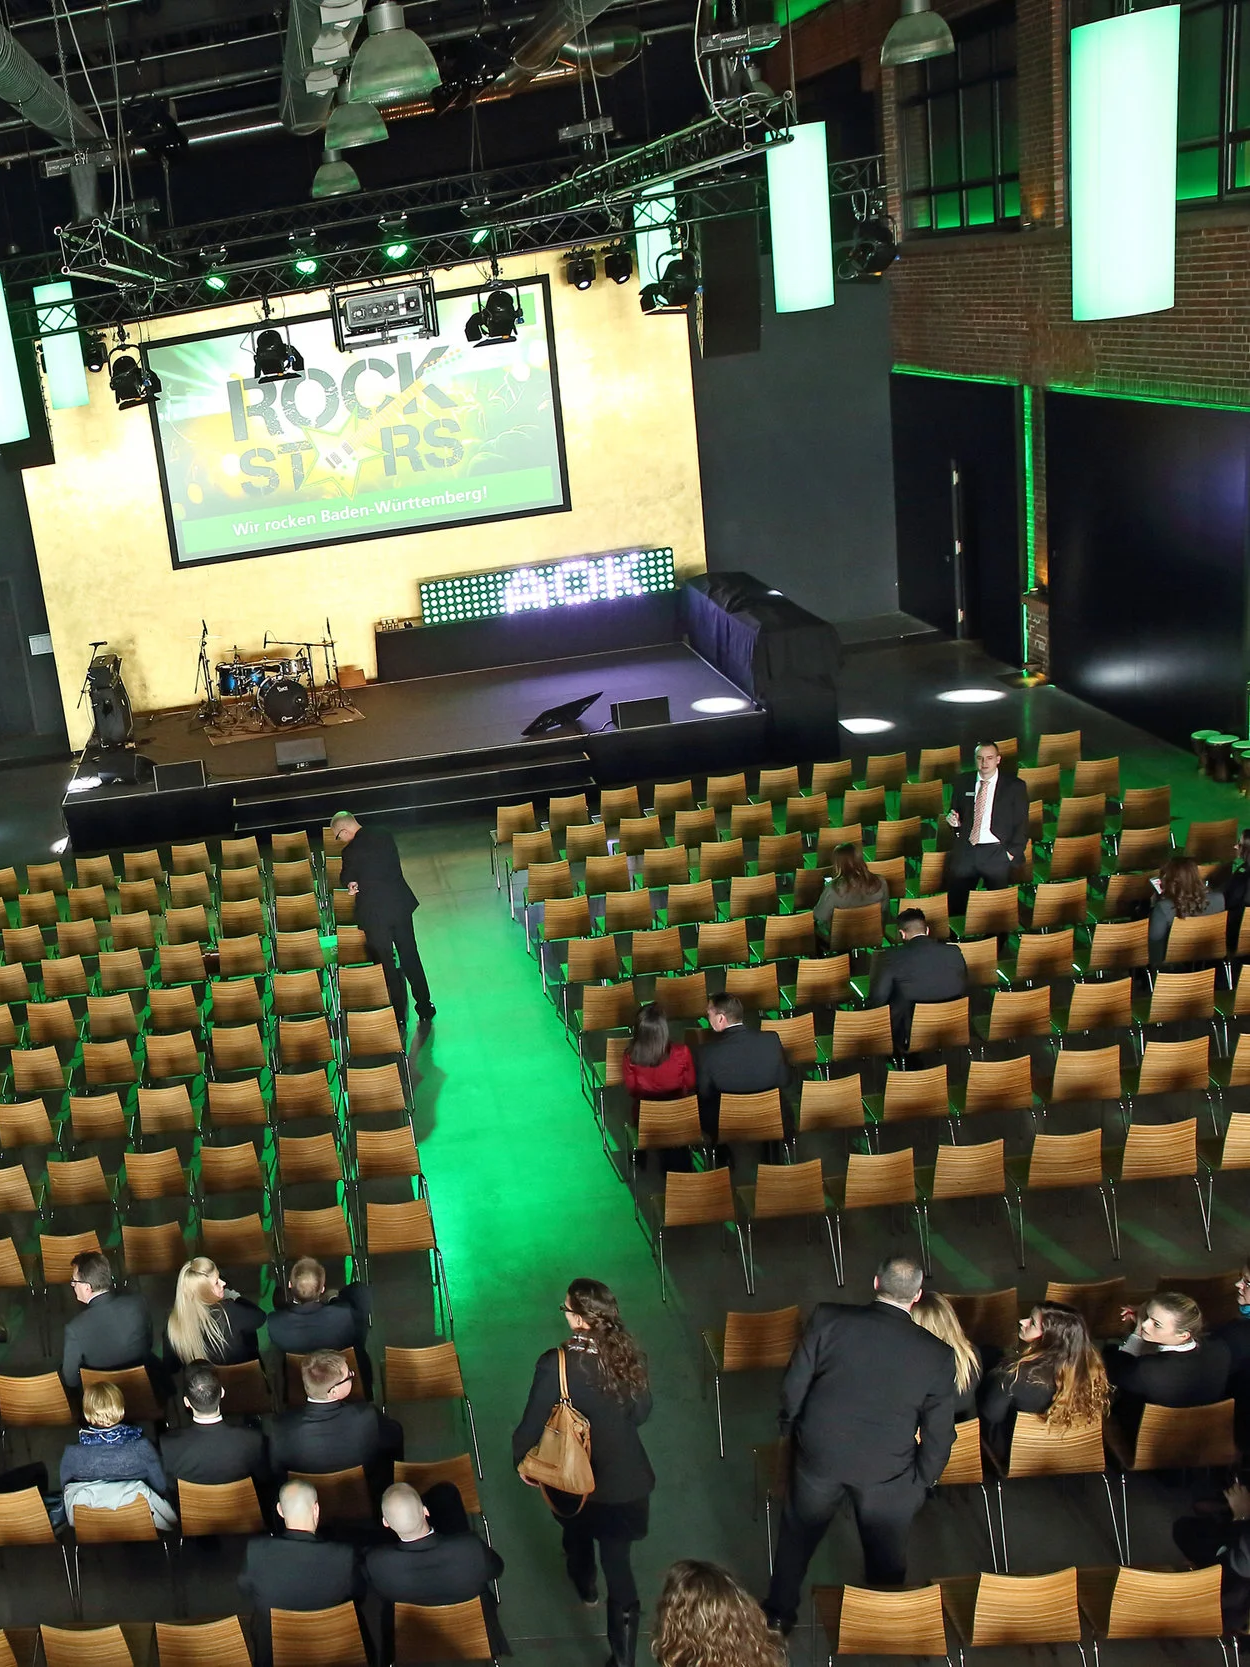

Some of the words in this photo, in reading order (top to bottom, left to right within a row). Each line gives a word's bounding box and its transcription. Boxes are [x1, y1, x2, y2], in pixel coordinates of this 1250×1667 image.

[226, 345, 458, 442] ROCK
[239, 418, 465, 496] STRS
[232, 521, 260, 537] Wir
[265, 513, 317, 532] rocken
[321, 486, 488, 523] Baden-Württemberg!
[505, 551, 644, 614] AOK
